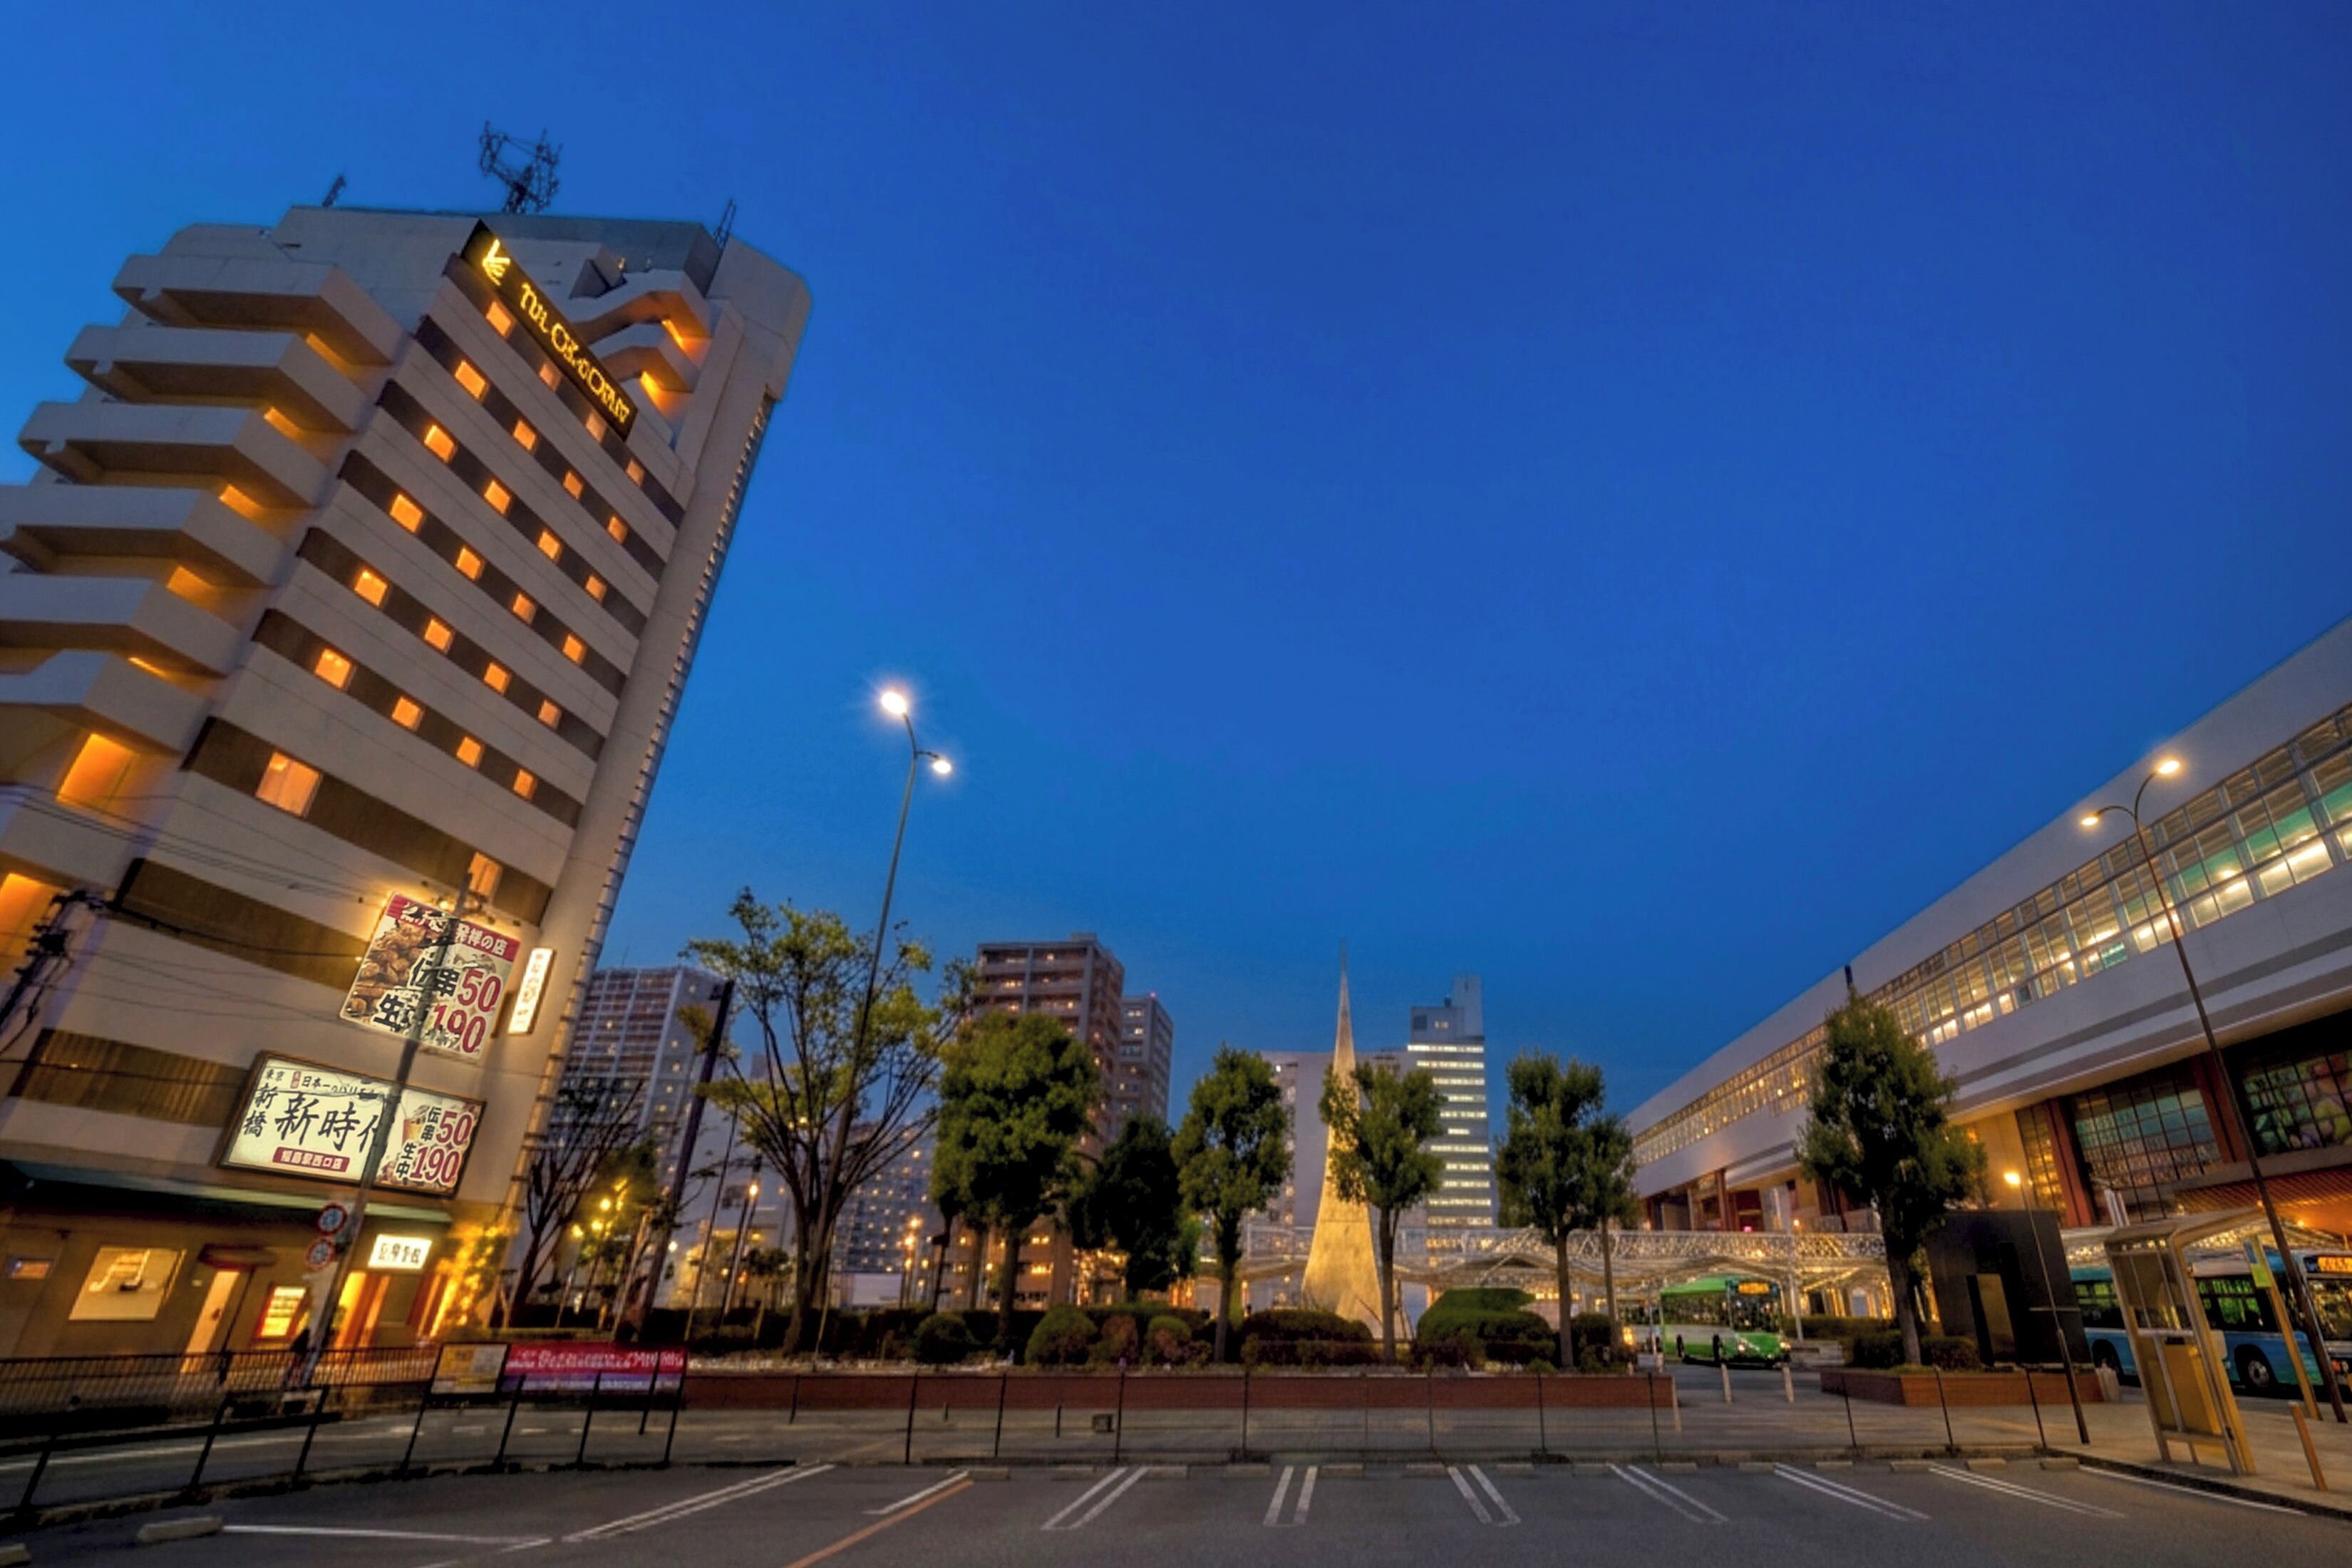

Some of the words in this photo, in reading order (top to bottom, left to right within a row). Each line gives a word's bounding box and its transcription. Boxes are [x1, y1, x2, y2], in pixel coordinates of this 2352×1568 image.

[457, 968, 502, 1013] 50
[435, 1110, 474, 1147] 50
[395, 1141, 417, 1179] 生中
[409, 1146, 460, 1185] 190
